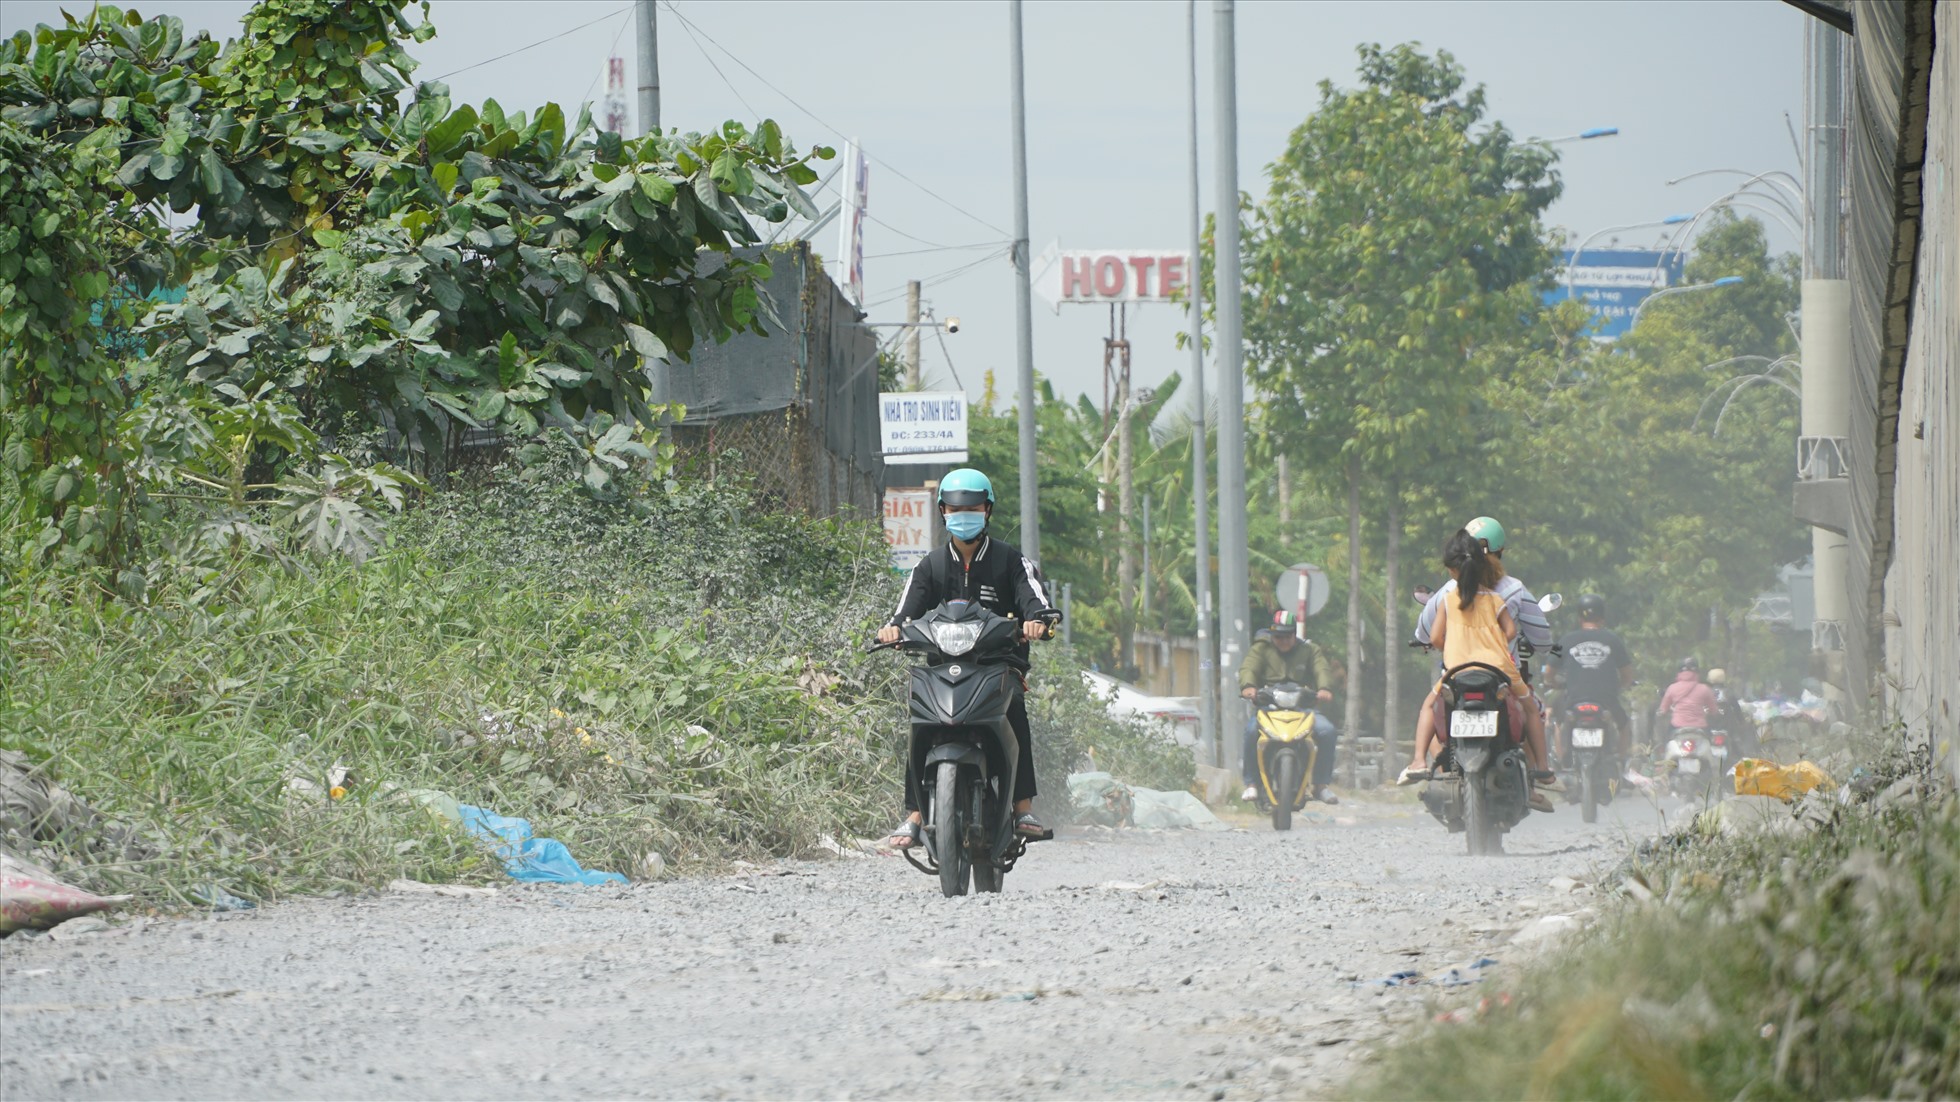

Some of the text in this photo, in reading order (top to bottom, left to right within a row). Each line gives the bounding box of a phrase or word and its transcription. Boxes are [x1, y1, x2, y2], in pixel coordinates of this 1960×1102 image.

[884, 396, 961, 426] NHÀ TRỌ SINH VIÊN
[914, 429, 954, 439] 233/4A
[1459, 711, 1489, 723] 95-E1
[1454, 725, 1494, 735] 077.16
